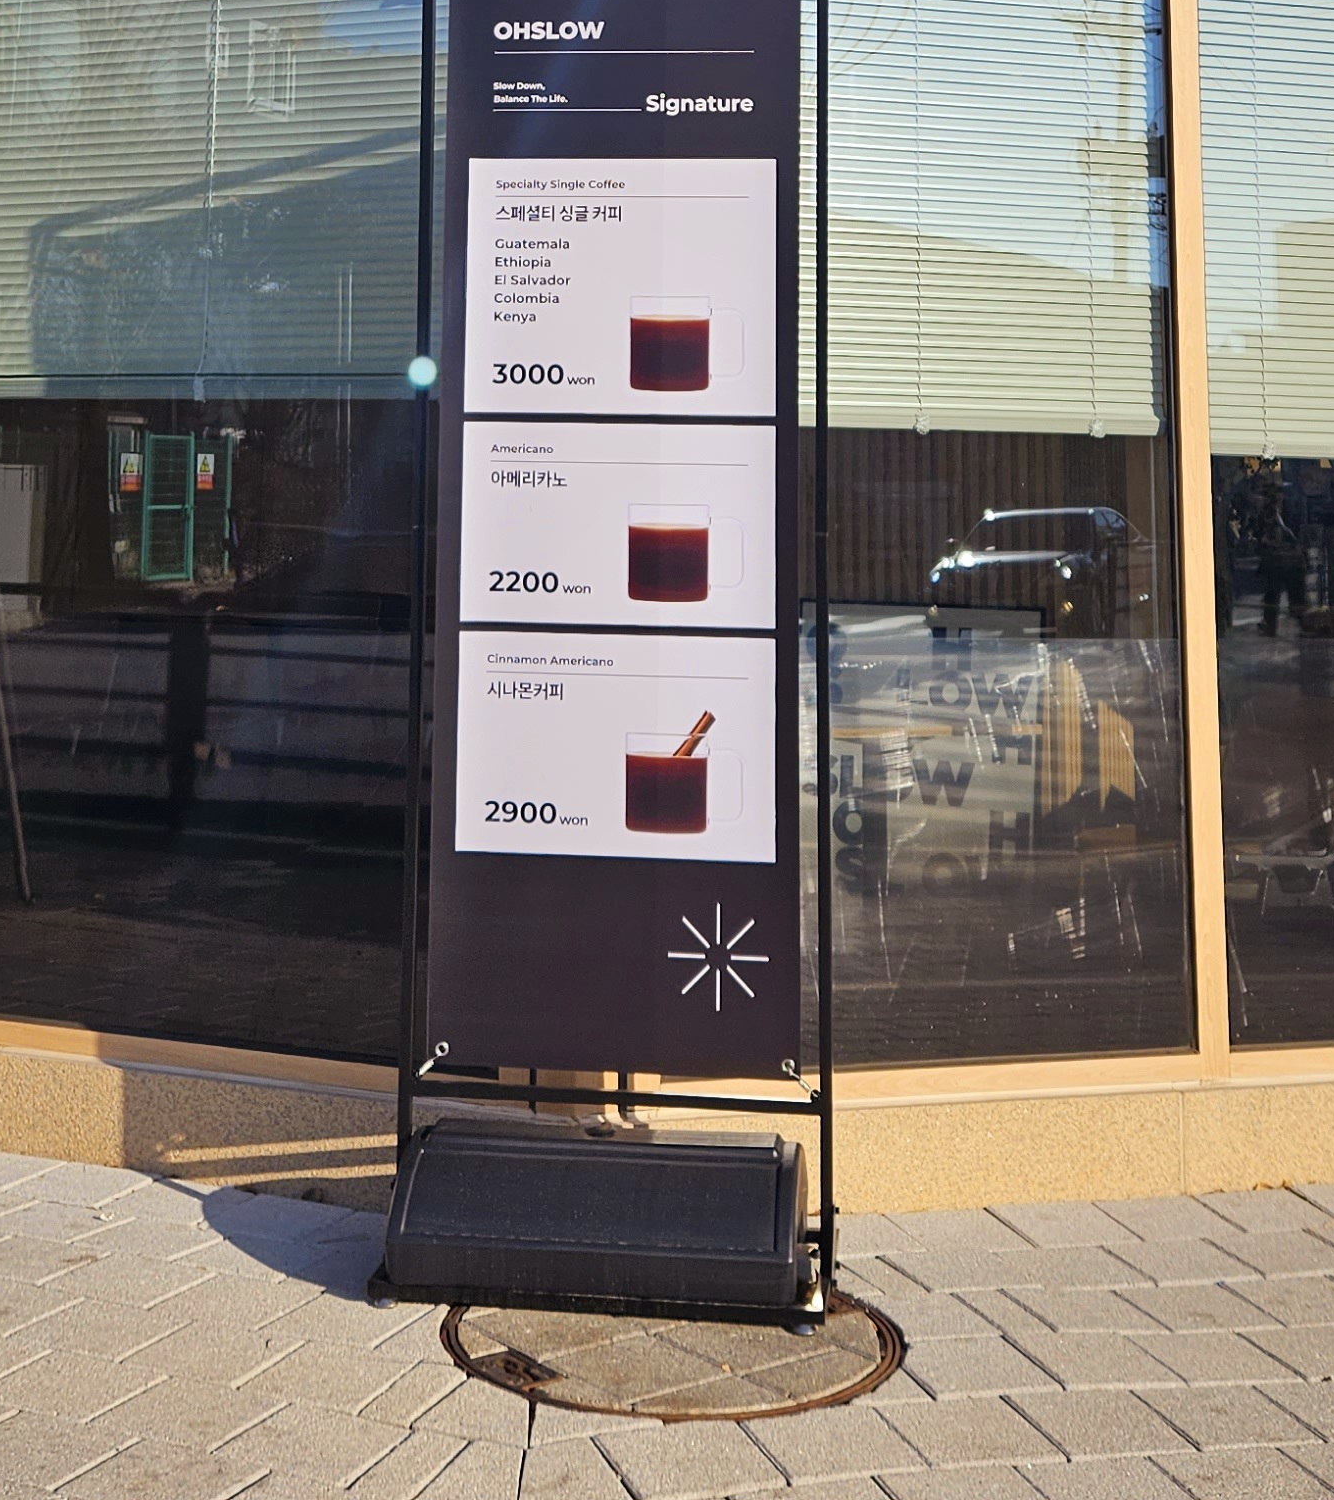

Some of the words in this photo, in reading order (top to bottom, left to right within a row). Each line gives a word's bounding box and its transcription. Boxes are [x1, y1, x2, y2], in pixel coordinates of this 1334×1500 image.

[493, 21, 605, 41] OHSLOW
[493, 81, 516, 91] Slow
[517, 81, 546, 92] Down,
[493, 93, 529, 103] Balance
[531, 93, 547, 103] The
[549, 93, 568, 103] Life.
[646, 92, 754, 116] Signature
[496, 179, 547, 191] Specialty
[550, 179, 585, 190] Single
[588, 179, 626, 190] Coffee
[495, 204, 555, 222] 스페셜티
[559, 204, 588, 222] 싱글
[592, 204, 622, 222] 커피
[495, 238, 570, 250] Guatemala
[494, 256, 551, 270] Ethiopia
[494, 275, 506, 285] El
[510, 274, 571, 286] Salvador
[494, 292, 560, 304] Colombia
[493, 311, 537, 325] Kenya
[492, 363, 564, 385] 3000
[567, 376, 595, 385] won
[491, 444, 554, 454] Americano
[491, 470, 568, 488] 아메리카노
[489, 570, 559, 593] 2200
[562, 584, 592, 594] won
[487, 653, 547, 665] Cinnamon
[550, 655, 614, 667] Americano
[487, 681, 564, 700] 시나몬커피
[484, 800, 557, 824] 2900
[559, 816, 588, 826] won
